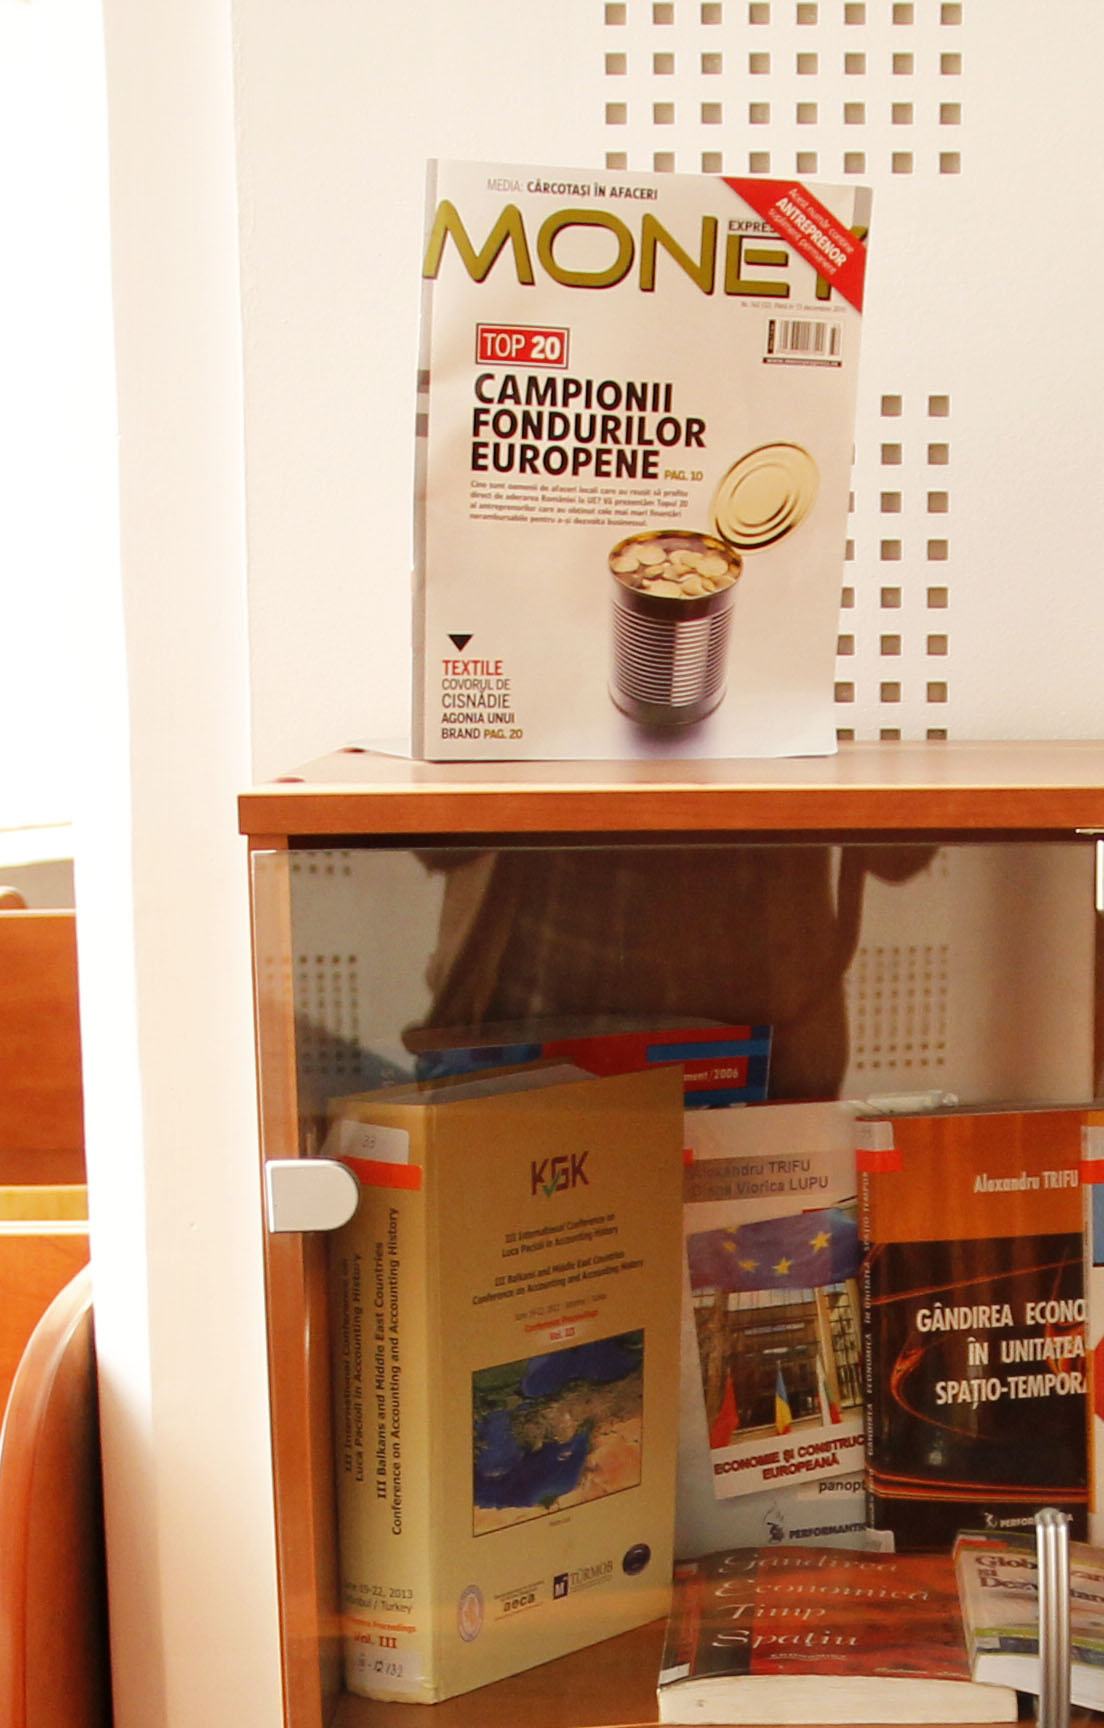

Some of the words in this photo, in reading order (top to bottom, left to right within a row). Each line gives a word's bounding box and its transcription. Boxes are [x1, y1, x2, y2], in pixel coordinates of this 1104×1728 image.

[609, 186, 658, 201] AFACERI
[776, 197, 848, 267] ANTREPRENOR
[483, 333, 525, 358] TOP
[530, 335, 561, 361] 20
[474, 373, 673, 413] CAMPIONII
[472, 408, 707, 448] FONDURILOR
[470, 442, 661, 480] EUROPENE
[693, 470, 704, 481] 10
[442, 660, 503, 676] TEXTILE
[441, 679, 493, 691] COVORUL
[495, 679, 511, 691] DE
[441, 712, 485, 724] AGONIA
[487, 712, 515, 724] UNUI
[441, 728, 481, 740] BRAND
[509, 728, 523, 739] 20
[768, 1160, 811, 1174] TRIFU
[737, 1180, 785, 1195] Viorica
[789, 1176, 829, 1190] LUPU
[973, 1173, 1040, 1193] Alexandru
[1043, 1169, 1079, 1189] TRIFU
[387, 1207, 400, 1256] History
[372, 1242, 384, 1309] Countries
[387, 1258, 401, 1343] Accounting
[374, 1314, 384, 1341] East
[916, 1303, 1014, 1333] GÂNDIREA
[389, 1346, 400, 1364] and
[967, 1337, 989, 1366] ÎN
[1002, 1336, 1085, 1364] UNITATEA
[374, 1345, 385, 1391] Middle
[375, 1394, 386, 1420] and
[389, 1367, 402, 1439] Accounting
[375, 1423, 386, 1477] Balkans
[391, 1443, 402, 1460] on
[714, 1452, 780, 1475] ECONOMIE
[377, 1479, 387, 1500] III
[391, 1462, 403, 1535] Conference
[389, 1587, 413, 1599] 2013
[382, 1600, 413, 1615] Turkey
[719, 1603, 827, 1621] Timp
[378, 1636, 397, 1649] III
